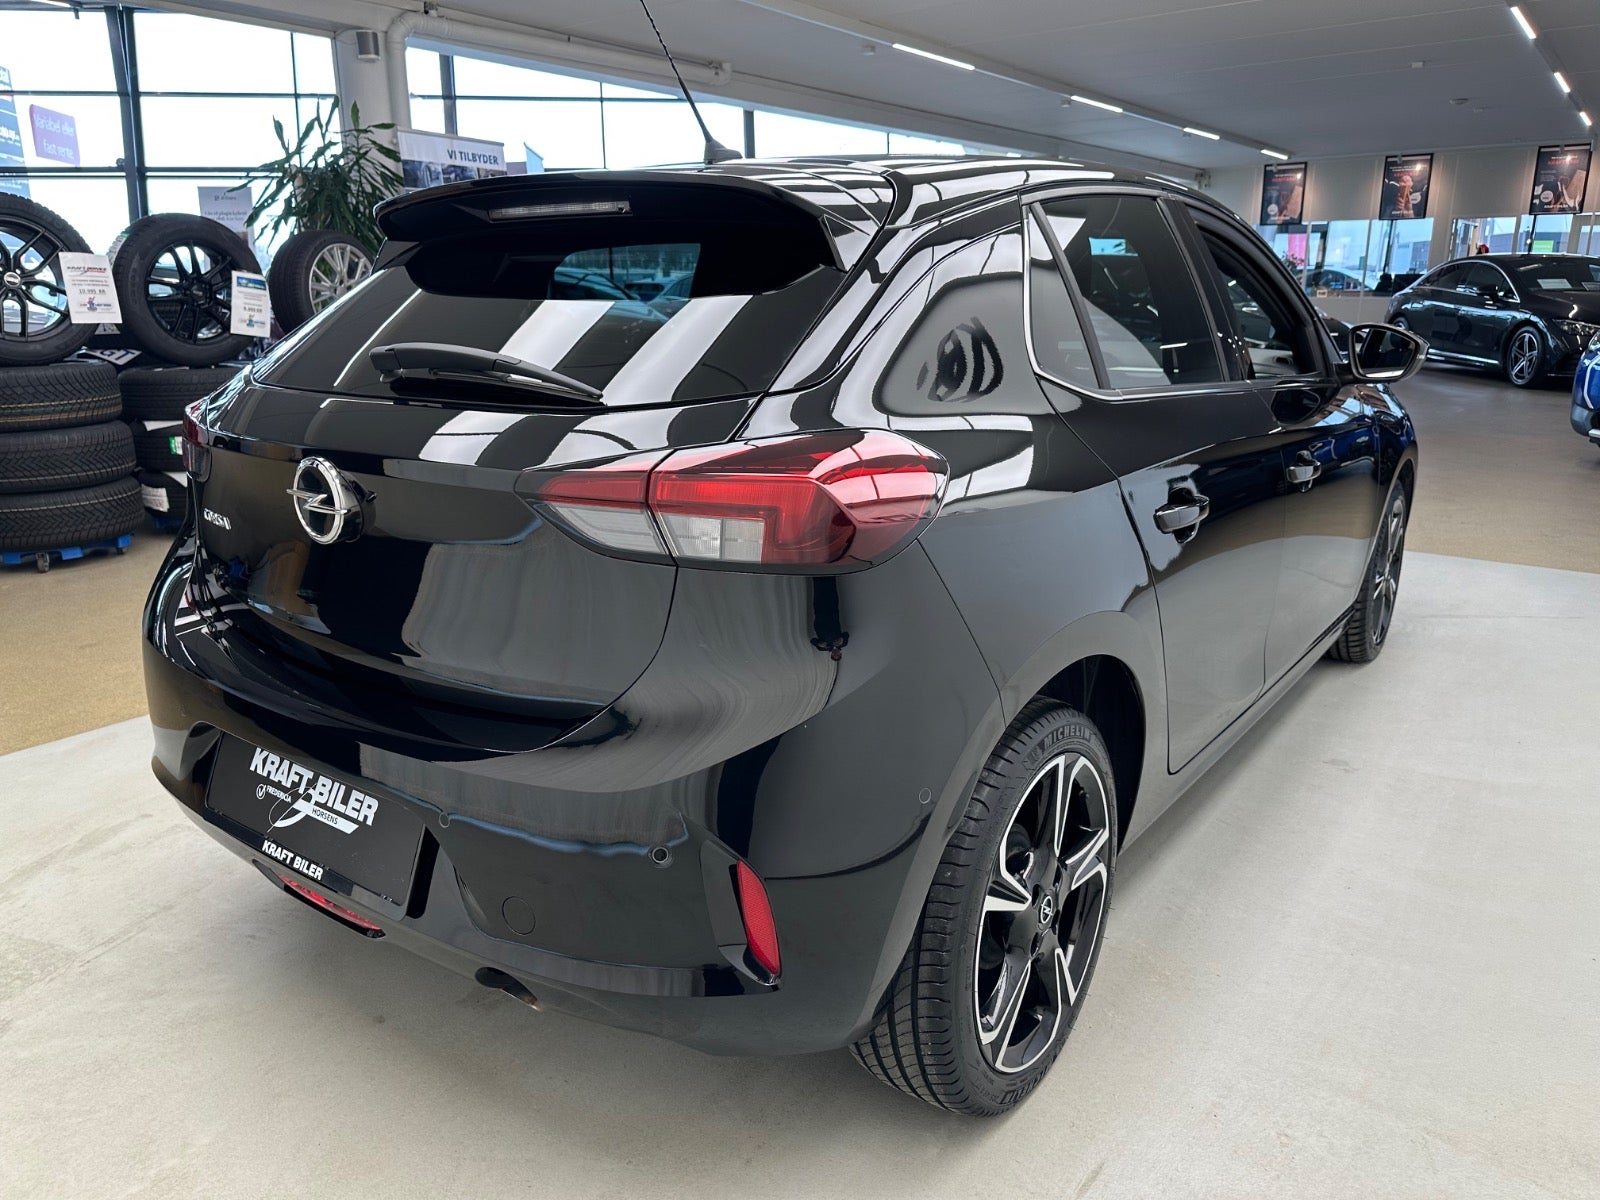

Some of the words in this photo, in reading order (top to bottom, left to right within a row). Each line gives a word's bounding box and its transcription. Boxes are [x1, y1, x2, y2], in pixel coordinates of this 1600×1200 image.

[447, 149, 457, 160] VI
[458, 151, 499, 166] TILBYDER
[1043, 724, 1093, 748] MICHELIN
[249, 747, 314, 794] KRAFT
[314, 775, 379, 826] BILER
[311, 807, 338, 825] HORSENS
[261, 840, 294, 864] KRAFT
[294, 857, 324, 880] BILER
